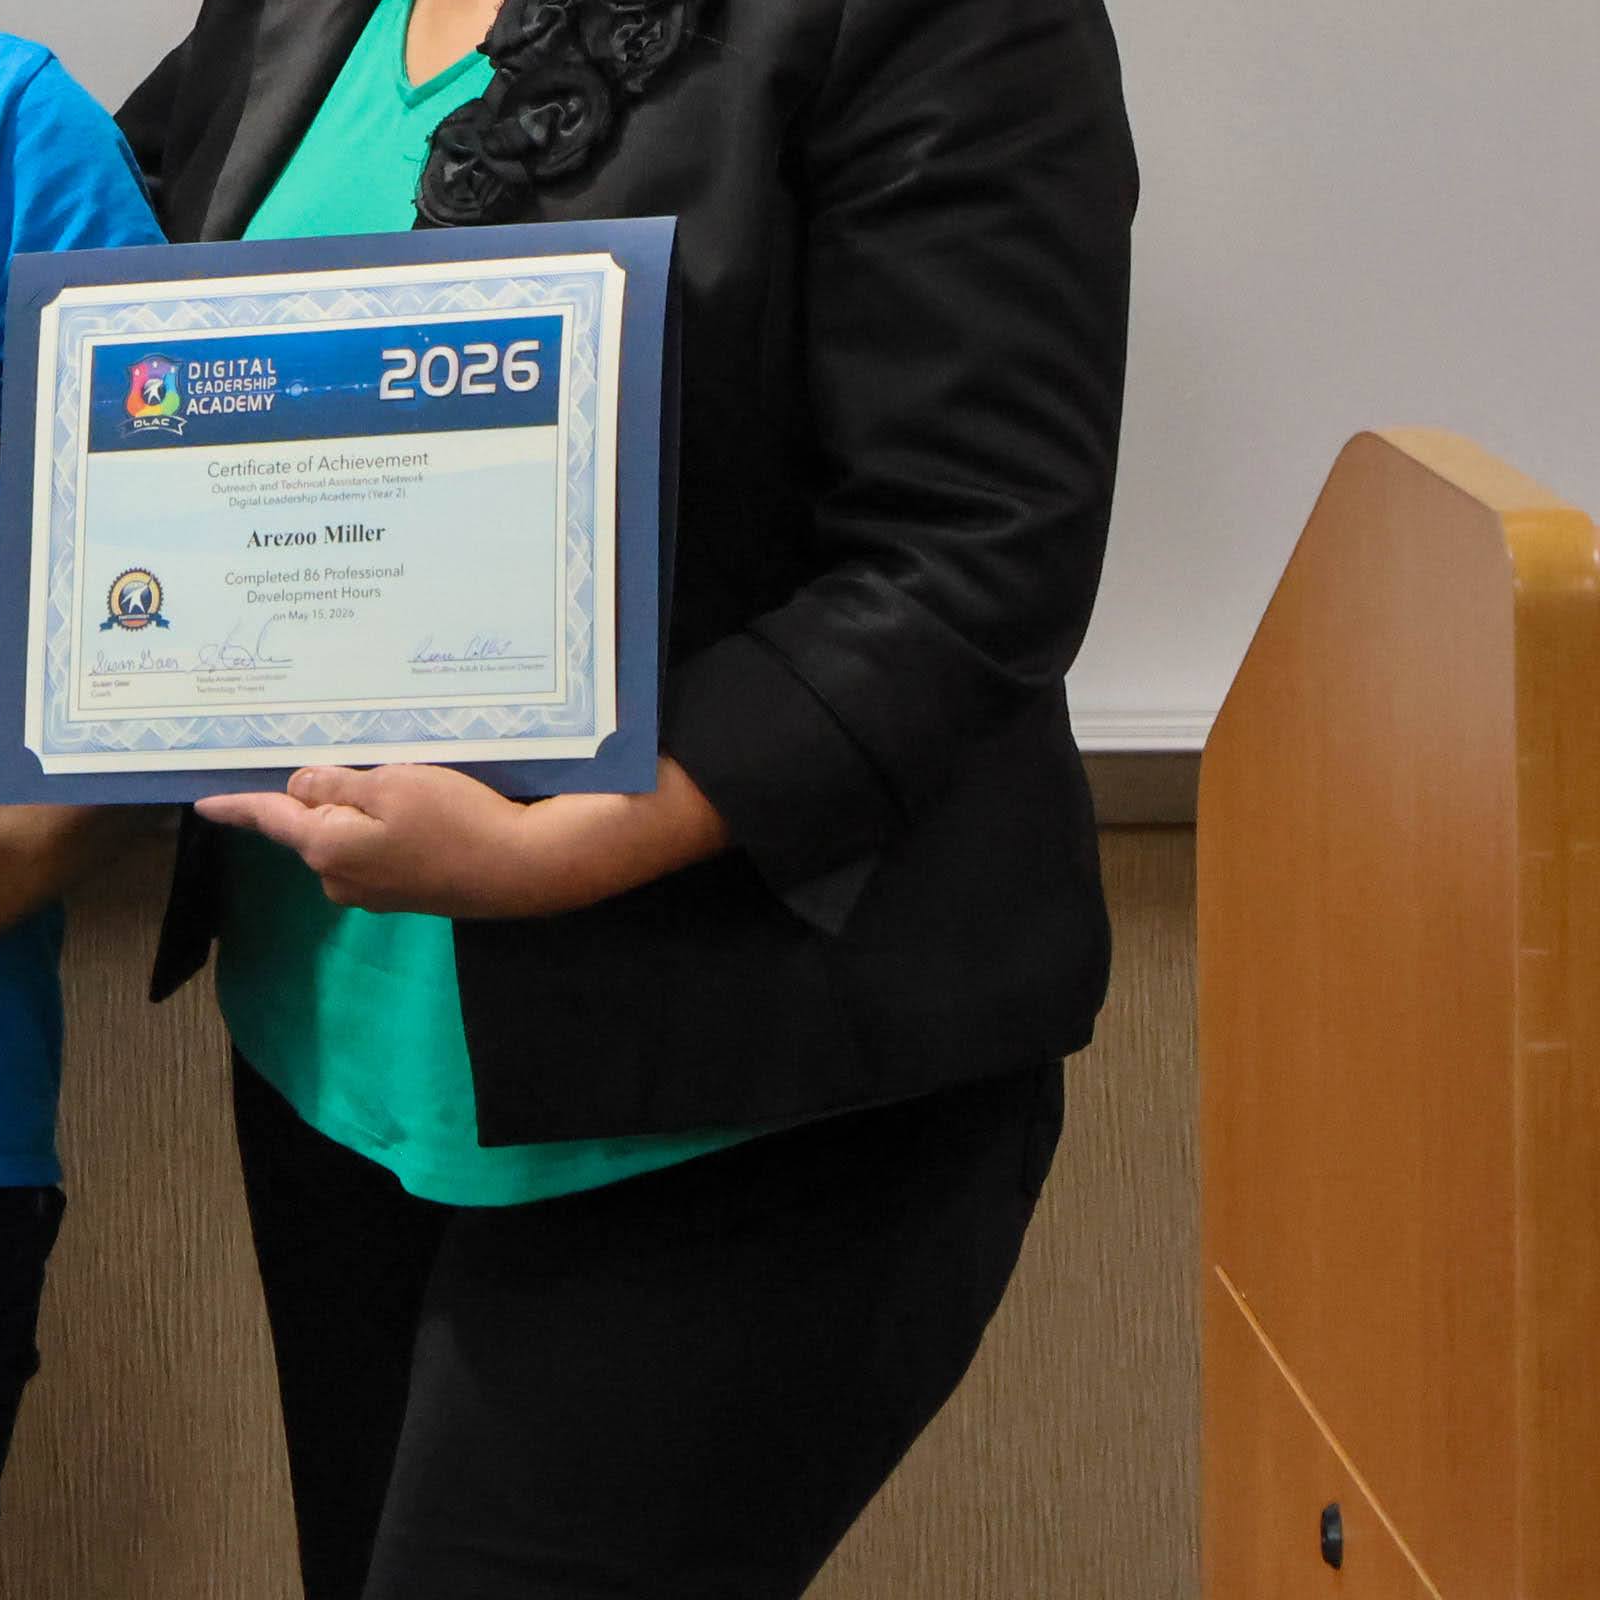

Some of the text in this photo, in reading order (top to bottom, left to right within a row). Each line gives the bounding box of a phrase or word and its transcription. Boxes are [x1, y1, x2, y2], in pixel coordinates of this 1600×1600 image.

[188, 357, 276, 380] DIGITAL
[378, 340, 541, 400] 2026
[187, 376, 277, 395] LEADERSHIP
[186, 394, 275, 416] ACADEMY
[134, 418, 171, 428] DLAC
[207, 452, 429, 478] Certificate of Achievement
[211, 472, 424, 494] Outreach and Technical Assistance Network
[228, 497, 261, 509] Digital
[263, 494, 318, 506] Leadership
[320, 491, 366, 504] Academy
[246, 524, 386, 548] Arezoo Miller
[224, 564, 404, 586] Completed 86 Professional
[247, 586, 381, 604] Development Hours
[272, 612, 286, 622] on
[288, 609, 309, 622] May
[329, 608, 355, 619] 2026
